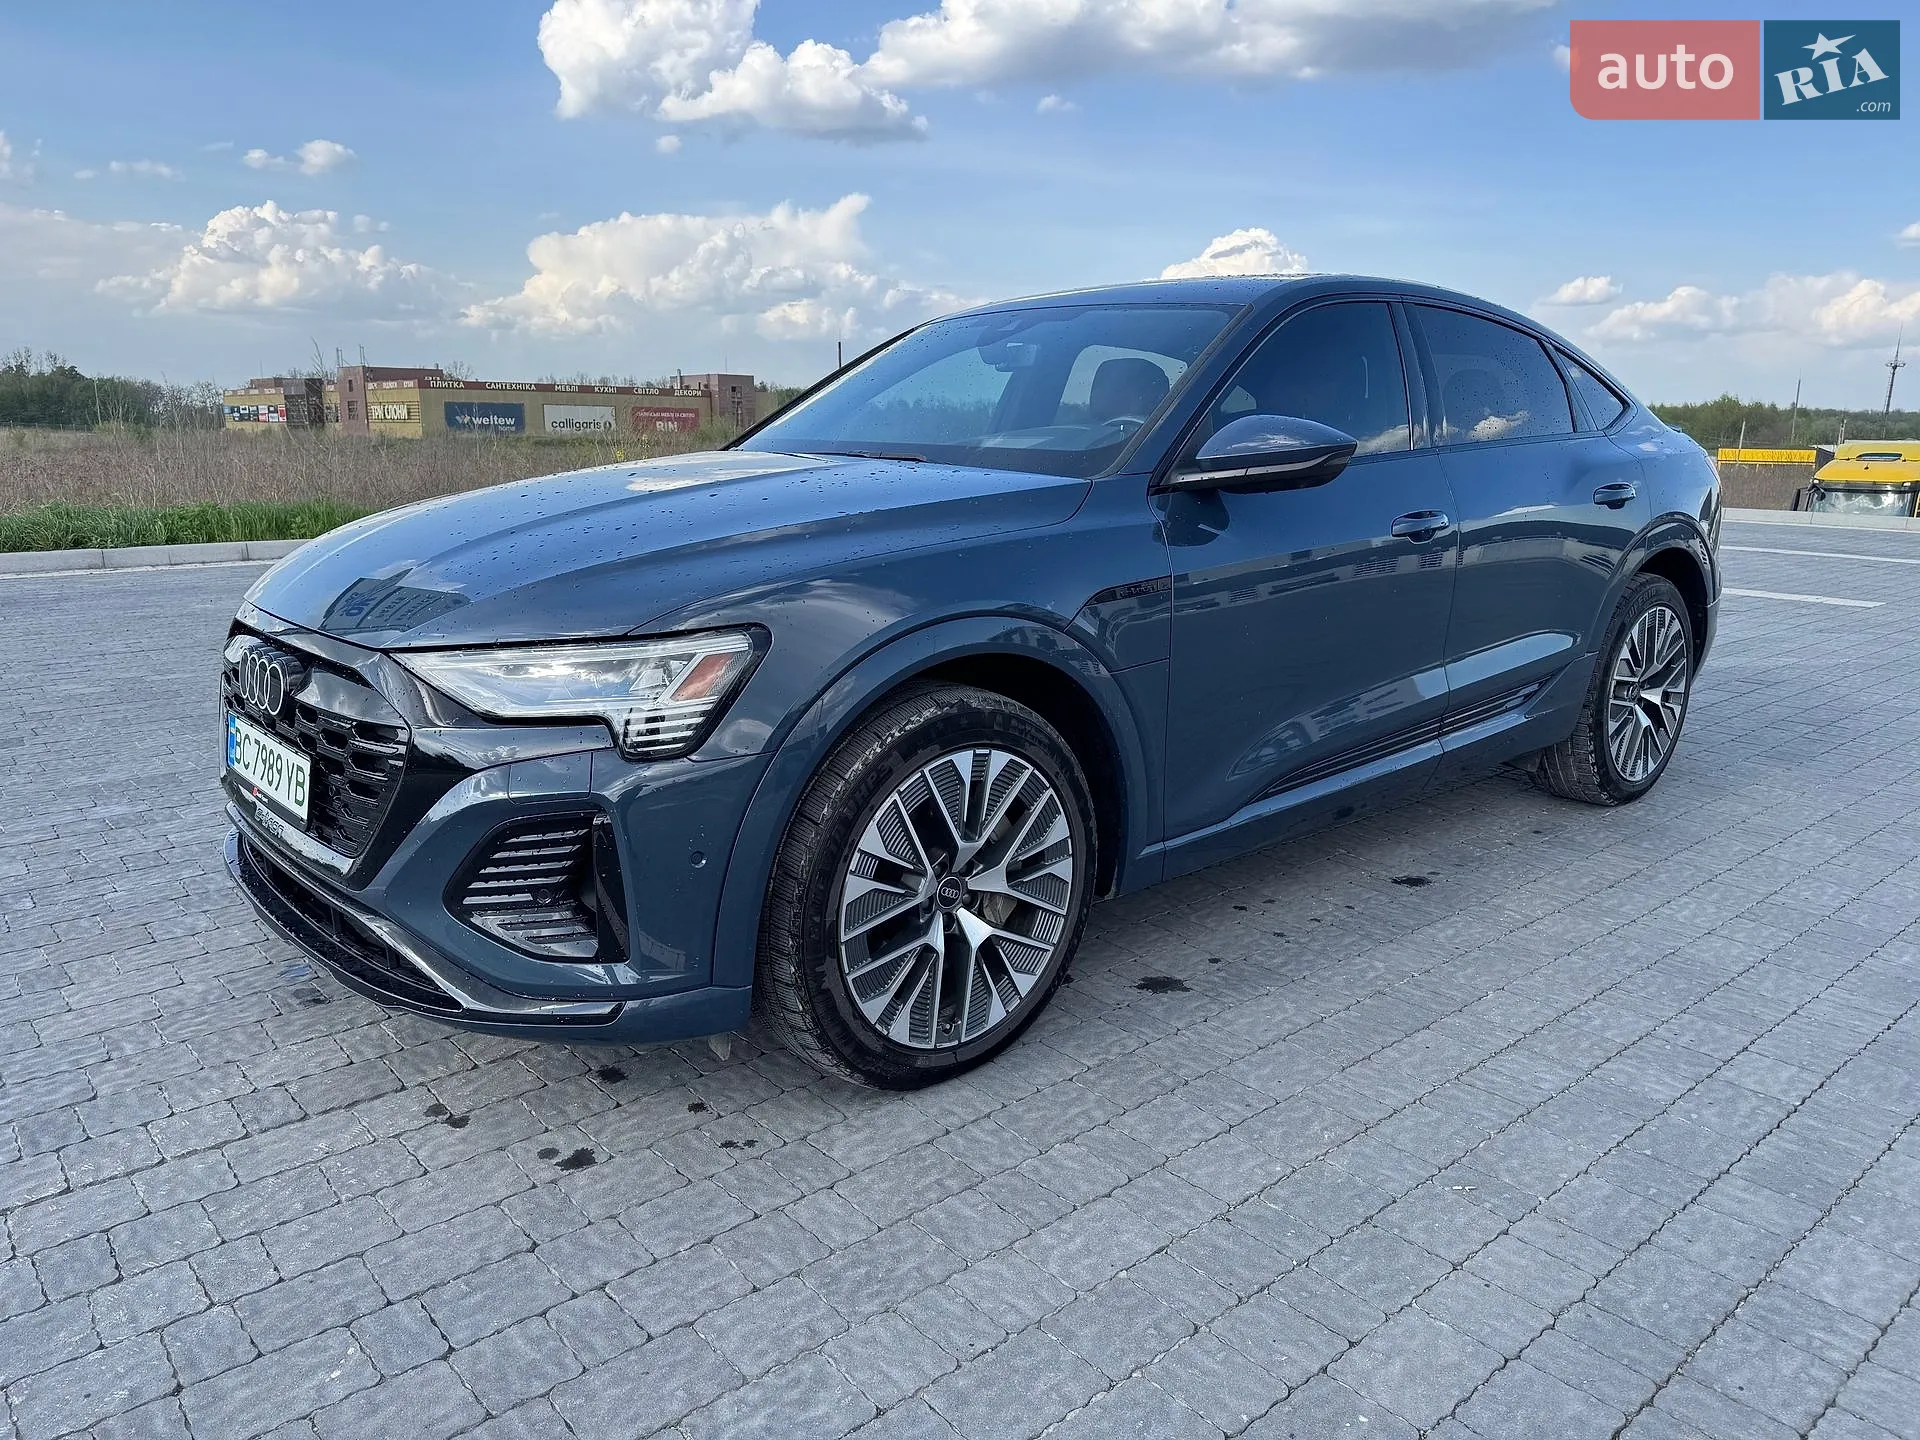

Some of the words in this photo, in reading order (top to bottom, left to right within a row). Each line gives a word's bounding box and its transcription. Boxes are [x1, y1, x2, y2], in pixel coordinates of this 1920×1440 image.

[430, 380, 465, 389] ПЛИТКА
[485, 382, 537, 391] САНТЕХНІКА
[554, 384, 579, 392] МЕБЛІ
[633, 387, 660, 395] СВІТЛО
[674, 389, 702, 397] ДЕКОРИ
[370, 405, 384, 420] ТРИ
[384, 403, 408, 420] СЛОНИ
[471, 415, 516, 425] weltew
[551, 418, 602, 432] calligaris
[234, 726, 252, 770] BC
[252, 738, 283, 792] 7989
[286, 758, 306, 807] YB
